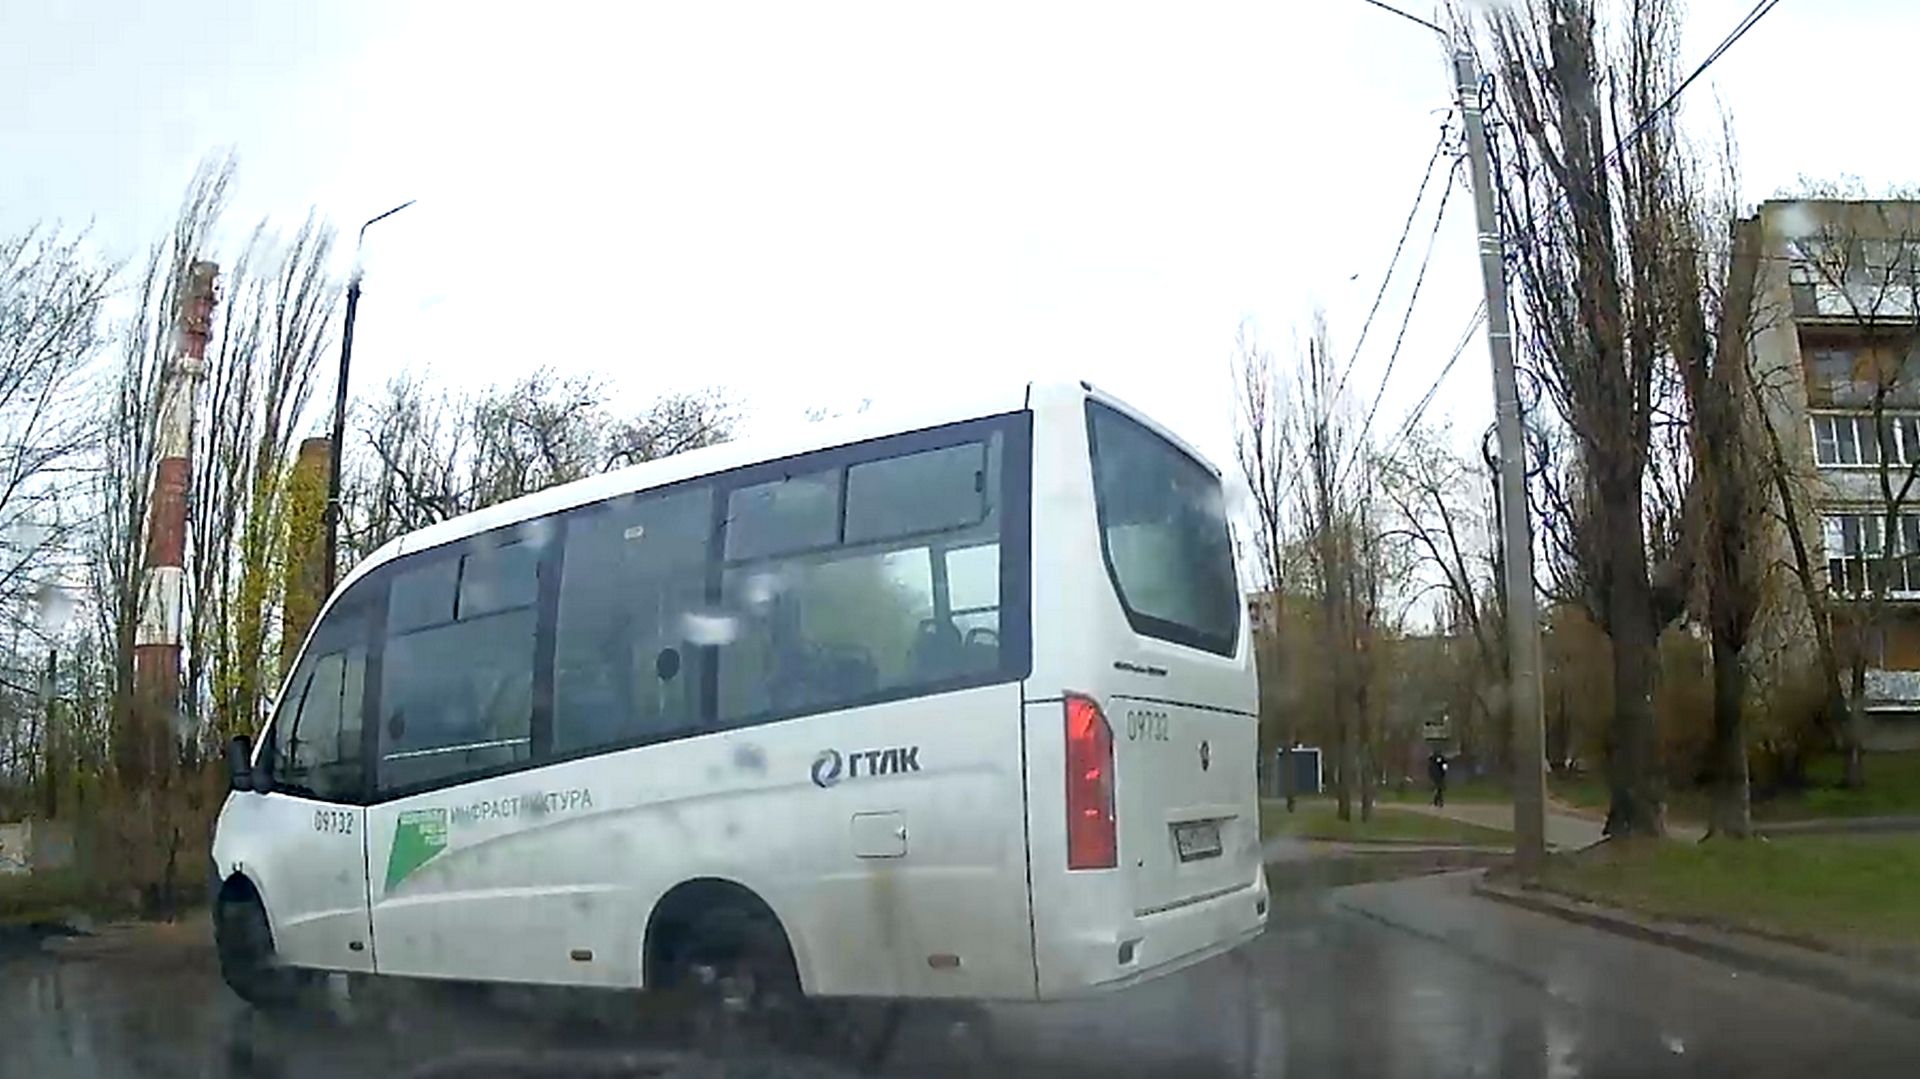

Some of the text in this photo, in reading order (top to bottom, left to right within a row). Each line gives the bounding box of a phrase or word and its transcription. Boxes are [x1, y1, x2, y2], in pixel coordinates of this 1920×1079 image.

[1126, 710, 1169, 741] 09732
[849, 746, 920, 778] ГТЛК
[314, 809, 354, 835] 09732
